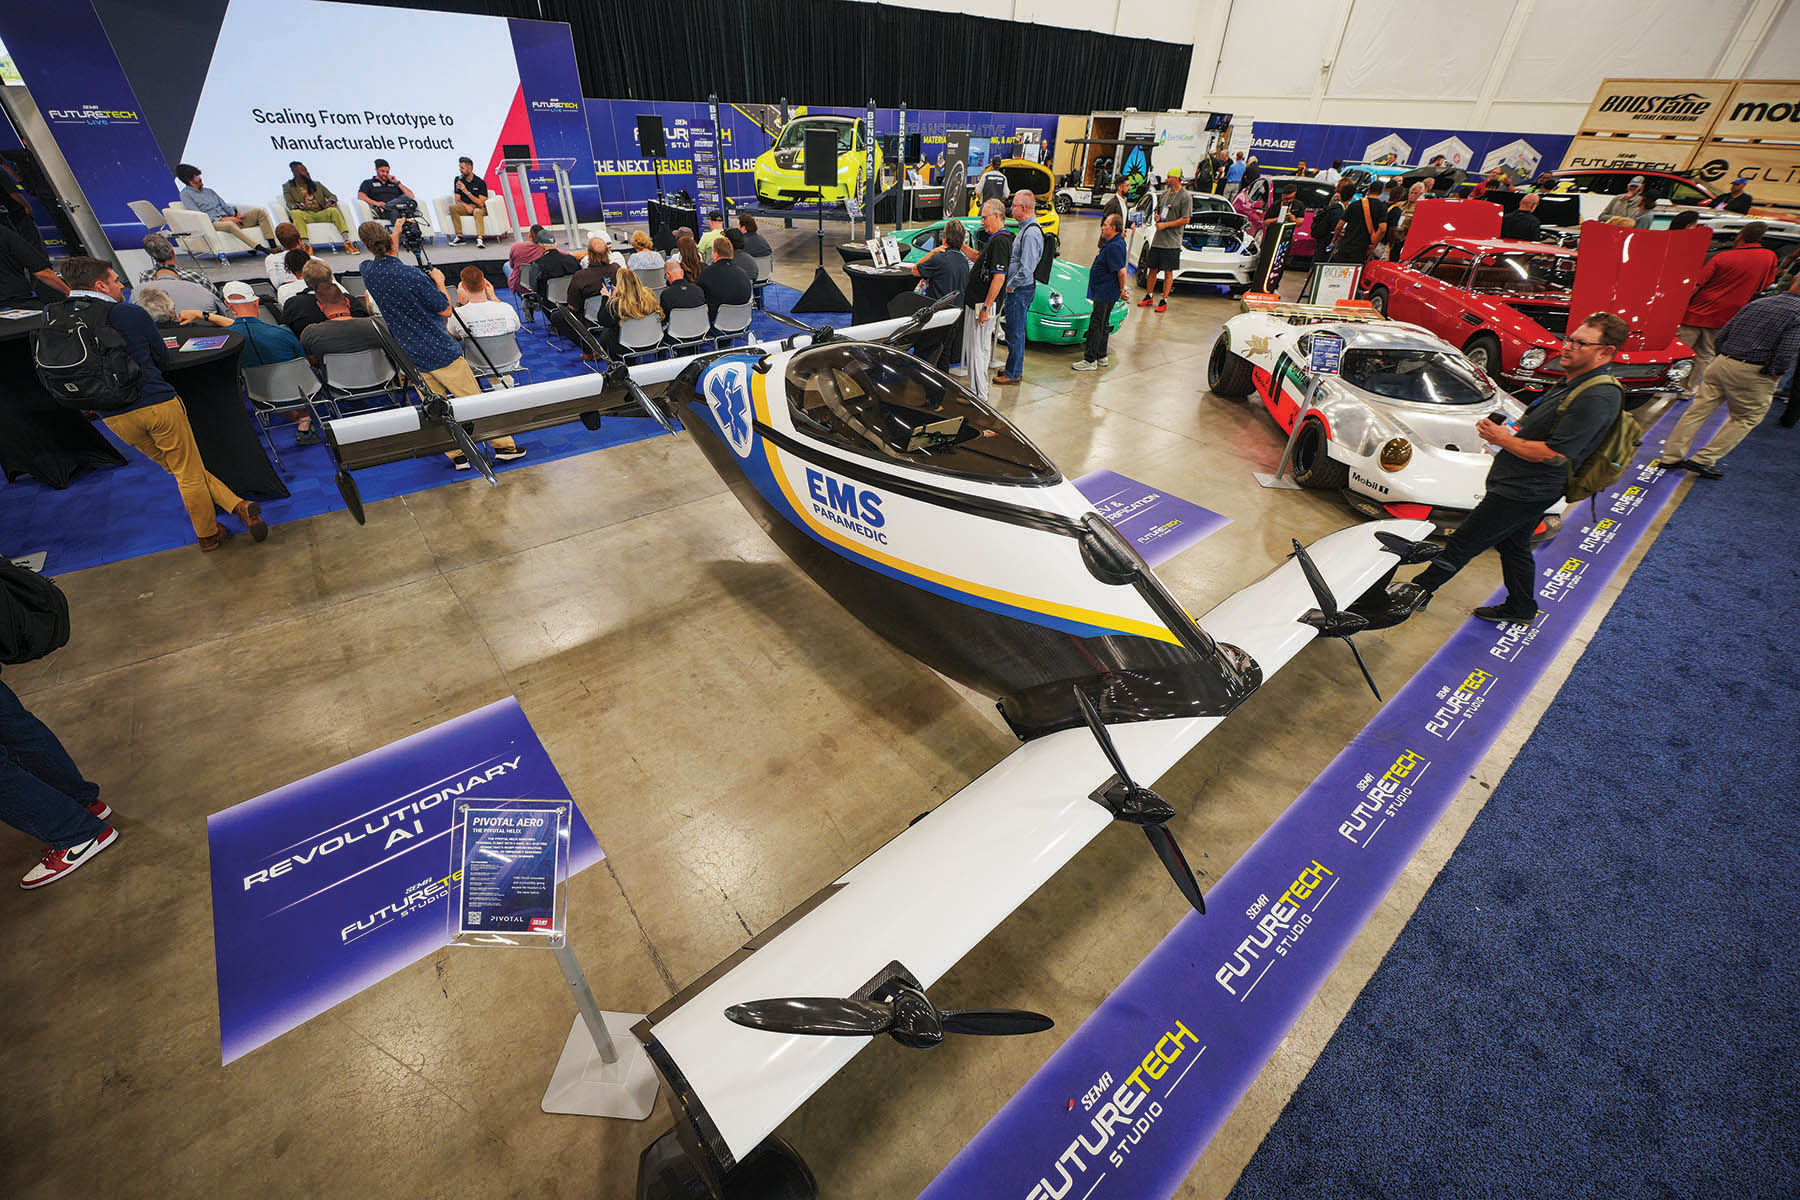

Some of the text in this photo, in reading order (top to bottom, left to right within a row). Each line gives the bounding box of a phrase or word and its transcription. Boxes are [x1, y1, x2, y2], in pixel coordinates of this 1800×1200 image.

[48, 110, 139, 121] FUTURETECH
[252, 108, 454, 129] Scaling From Prototype to
[532, 101, 579, 109] FUTURETECH
[271, 135, 455, 150] Manufacturable Product
[866, 111, 875, 169] BENDPAK
[616, 160, 649, 173] NEXT
[729, 160, 740, 171] IS
[1569, 157, 1677, 171] FUTURETECH
[1352, 471, 1379, 490] Mobil
[805, 467, 886, 529] EMS
[812, 502, 889, 546] PARAMEDIC
[1578, 517, 1617, 553] FUTURETECH
[1539, 556, 1585, 601] FUTURETECH
[1521, 628, 1540, 647] STUDIO
[1424, 667, 1494, 738] FUTURETECH
[1435, 684, 1452, 700] SEMA
[1463, 696, 1486, 720] STUDIO
[1338, 748, 1426, 844] FUTURETECH
[1356, 772, 1376, 793] SEMA
[1385, 786, 1413, 818] STUDIO
[242, 755, 522, 892] REVOLUTIONARY
[383, 819, 425, 850] AI
[472, 816, 544, 828] PIVOTAL AERO
[405, 876, 433, 895] SEMA
[340, 868, 463, 943] FUTURETE
[400, 890, 449, 918] STUDIO
[1245, 893, 1270, 921] SEMA
[490, 915, 524, 923] PIVOTAL
[1214, 859, 1334, 996] FUTURETECH
[1275, 913, 1313, 957] STUDIO
[1081, 1071, 1114, 1112] SEMA
[1109, 1101, 1164, 1169] STUDIO
